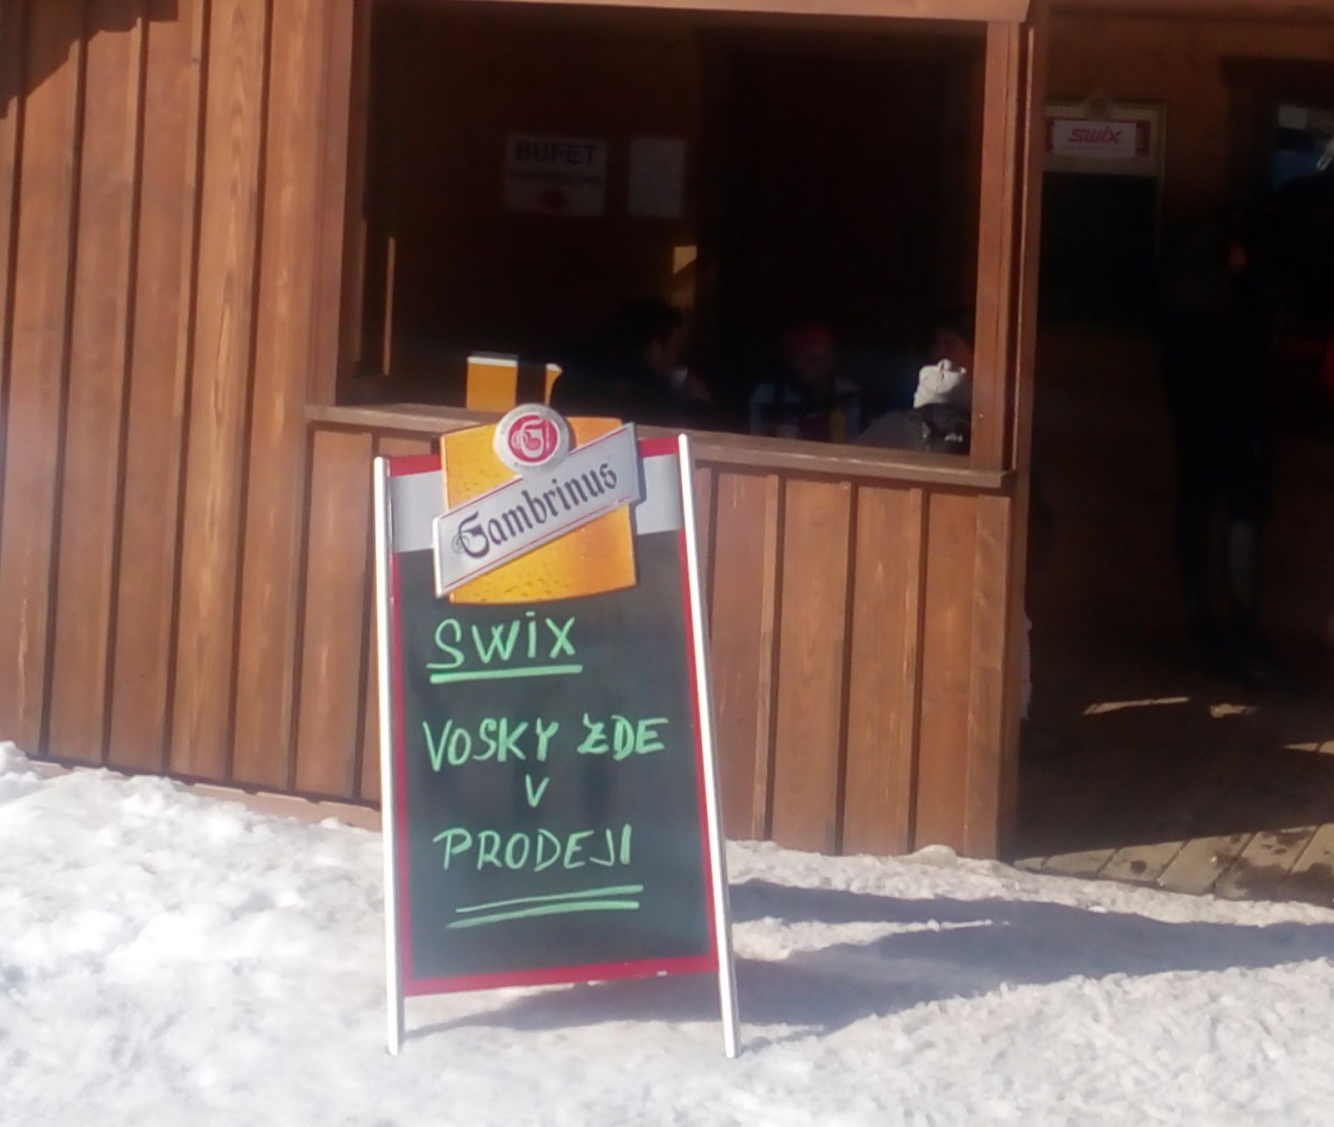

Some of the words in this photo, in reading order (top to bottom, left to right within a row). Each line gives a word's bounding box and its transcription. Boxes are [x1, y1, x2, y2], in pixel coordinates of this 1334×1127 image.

[515, 139, 598, 165] BUFET
[451, 462, 618, 559] Gambrinus
[423, 716, 560, 773] VOSKY
[432, 823, 633, 872] PRODEJI
